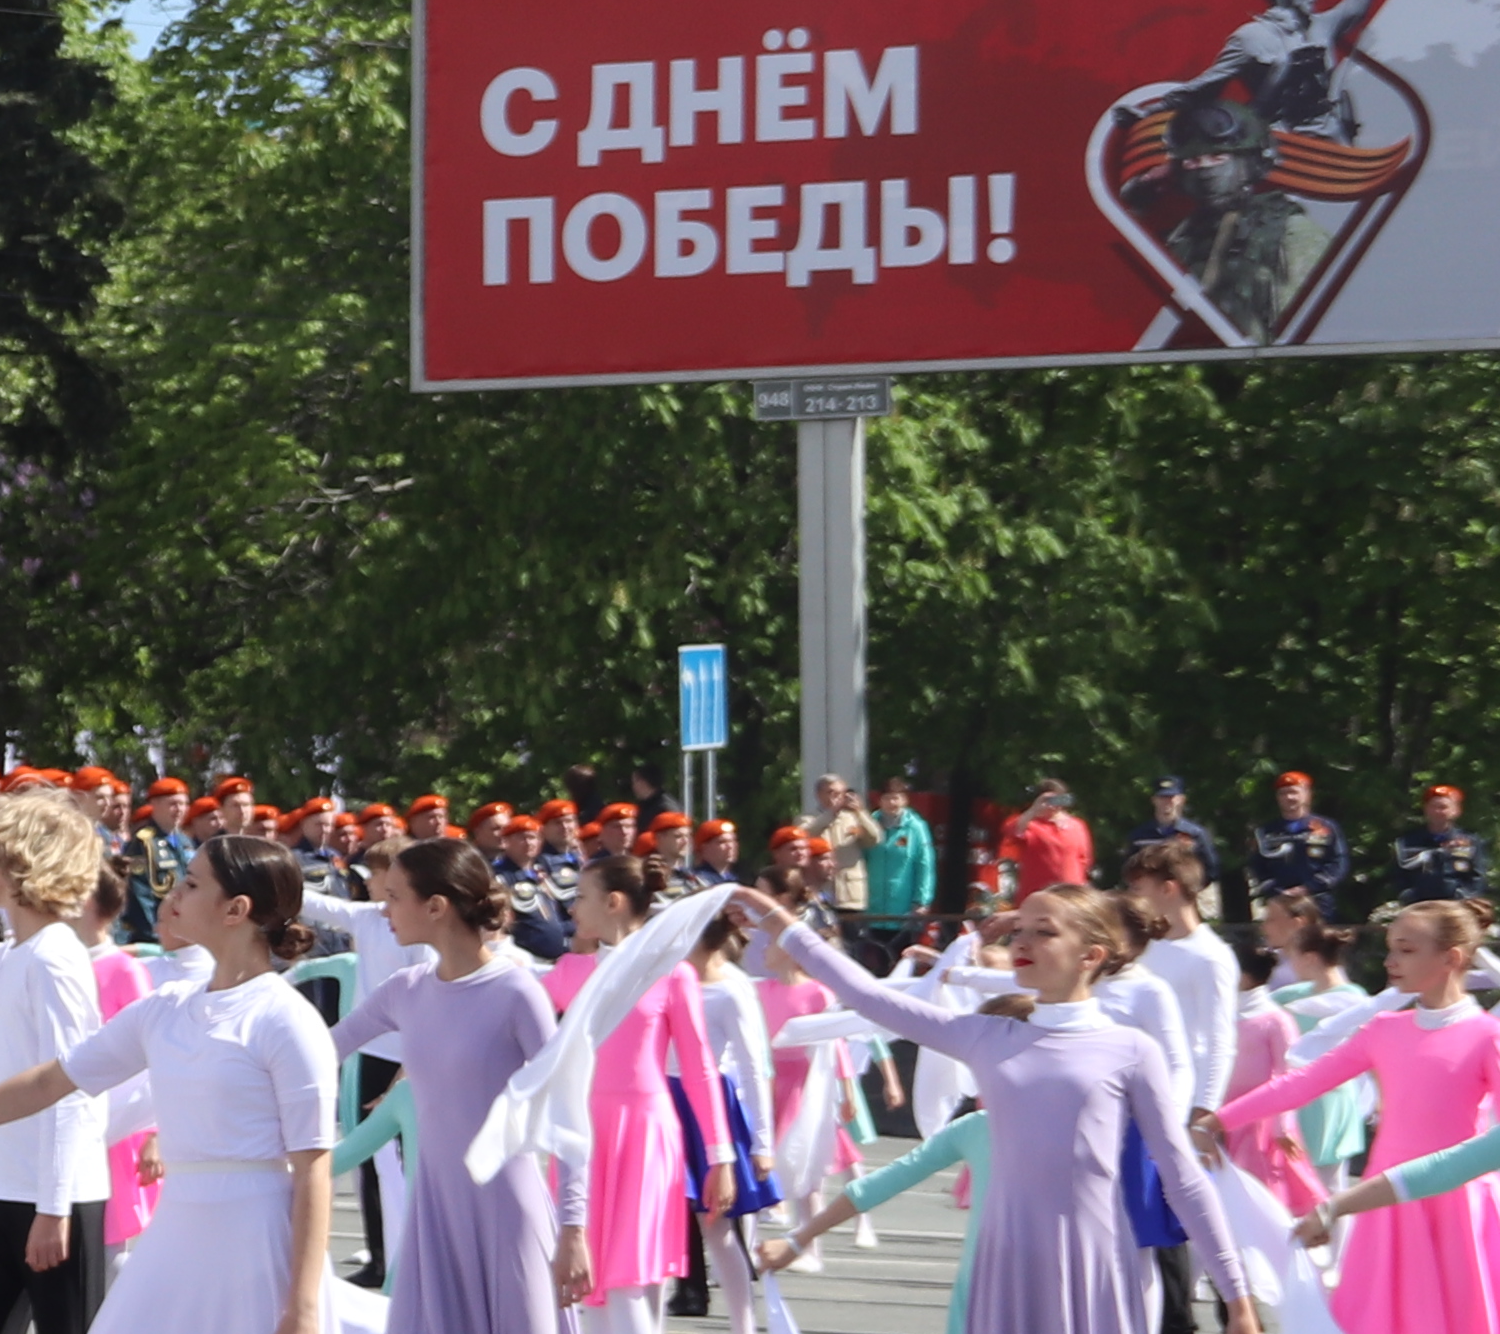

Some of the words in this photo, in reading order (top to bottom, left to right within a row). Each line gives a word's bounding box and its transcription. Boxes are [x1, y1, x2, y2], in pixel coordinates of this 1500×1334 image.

[479, 67, 558, 157] С
[577, 27, 920, 167] ДНЁМ
[482, 173, 1017, 288] ПОБЕДЫ!
[758, 390, 790, 409] 948
[805, 393, 877, 413] 214-213
